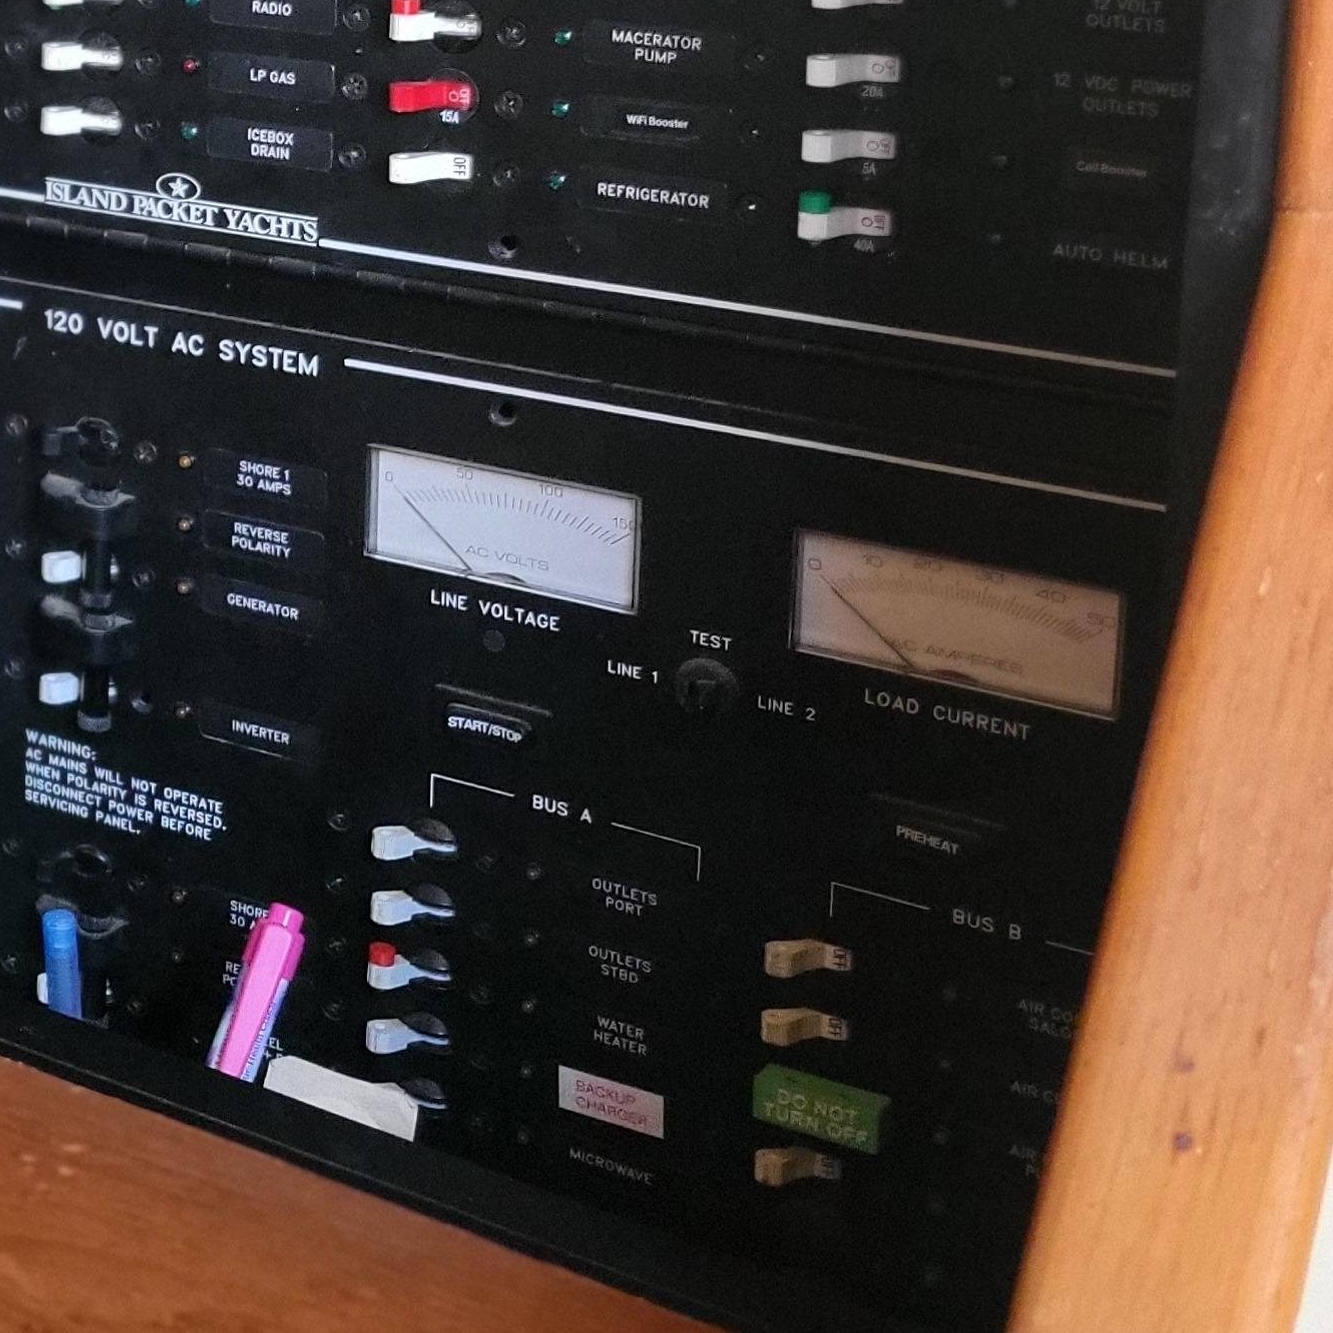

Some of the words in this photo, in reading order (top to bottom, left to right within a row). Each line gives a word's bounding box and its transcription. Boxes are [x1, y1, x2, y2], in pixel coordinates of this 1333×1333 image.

[252, 1, 292, 16] RADIO
[1086, 14, 1165, 32] OUTLETS
[612, 31, 701, 50] MACERATOR
[635, 48, 677, 63] PUMP
[250, 69, 266, 82] LP
[270, 70, 295, 85] GAS
[1054, 74, 1071, 87] 12
[1085, 76, 1118, 91] VDC
[1132, 79, 1192, 97] POWER
[440, 110, 459, 123] 15A
[1083, 98, 1159, 117] OUTLETS
[626, 114, 648, 127] WiFi
[649, 116, 689, 129] Booster
[248, 128, 294, 145] ICEBOX
[251, 144, 290, 160] DRAIN
[453, 157, 467, 177] OFF
[597, 183, 709, 209] REFRIGERATOR
[45, 180, 127, 212] ISLAND
[133, 195, 219, 226] PACKET
[224, 210, 317, 243] YACHTS
[1053, 243, 1101, 261] AUTO
[1114, 251, 1170, 270] HELM
[45, 309, 82, 334] 120
[98, 318, 158, 348] VOLT
[172, 332, 204, 356] AC
[219, 339, 318, 377] SYSTEM
[239, 461, 280, 478] SHORE
[284, 469, 289, 480] 1
[237, 474, 253, 487] 30
[257, 478, 291, 495] AMPS
[539, 484, 563, 498] 100
[234, 522, 289, 544] REVERSE
[232, 536, 291, 558] POLARITY
[466, 545, 490, 556] AC
[495, 550, 550, 571] VOLTS
[227, 594, 299, 620] GENERATOR
[431, 590, 468, 611] LINE
[479, 600, 560, 631] VOLTAGE
[690, 630, 731, 650] TEST
[607, 661, 641, 680] LINE
[652, 671, 659, 683] 1
[758, 695, 793, 716] LINE
[806, 708, 816, 721] 2
[865, 688, 919, 715] LOAD
[933, 705, 1030, 741] CURRENT
[232, 720, 290, 745] INVERTER
[448, 716, 522, 743] START/STOP
[25, 728, 97, 761] WARNING:
[26, 748, 42, 761] AC
[49, 754, 87, 775] MAINS
[94, 766, 123, 785] WILL
[132, 777, 157, 795] NOT
[164, 787, 223, 814] OPERATE
[25, 762, 60, 782] WHEN
[67, 771, 127, 800] POLARITY
[135, 794, 147, 806] IS
[154, 800, 227, 831] REVERSED.
[25, 789, 88, 819] SERVICING
[25, 775, 101, 807] DISCONNECT
[108, 801, 154, 824] POWER
[161, 816, 212, 841] BEFORE
[533, 795, 568, 817] BUS
[581, 809, 592, 823] A
[896, 825, 959, 856] PREHEAT
[592, 878, 658, 906] OUTLETS
[605, 896, 643, 916] PORT
[230, 913, 245, 926] 30
[953, 908, 994, 933] BUS
[1009, 924, 1021, 940] B
[589, 946, 652, 973] OUTLETS
[601, 964, 638, 984] STBD
[597, 1016, 644, 1041] WATER
[594, 1030, 647, 1056] HEATER
[575, 1080, 636, 1105] BACKUP
[575, 1096, 648, 1128] CHARGER
[569, 1148, 654, 1185] MICROWAVE
